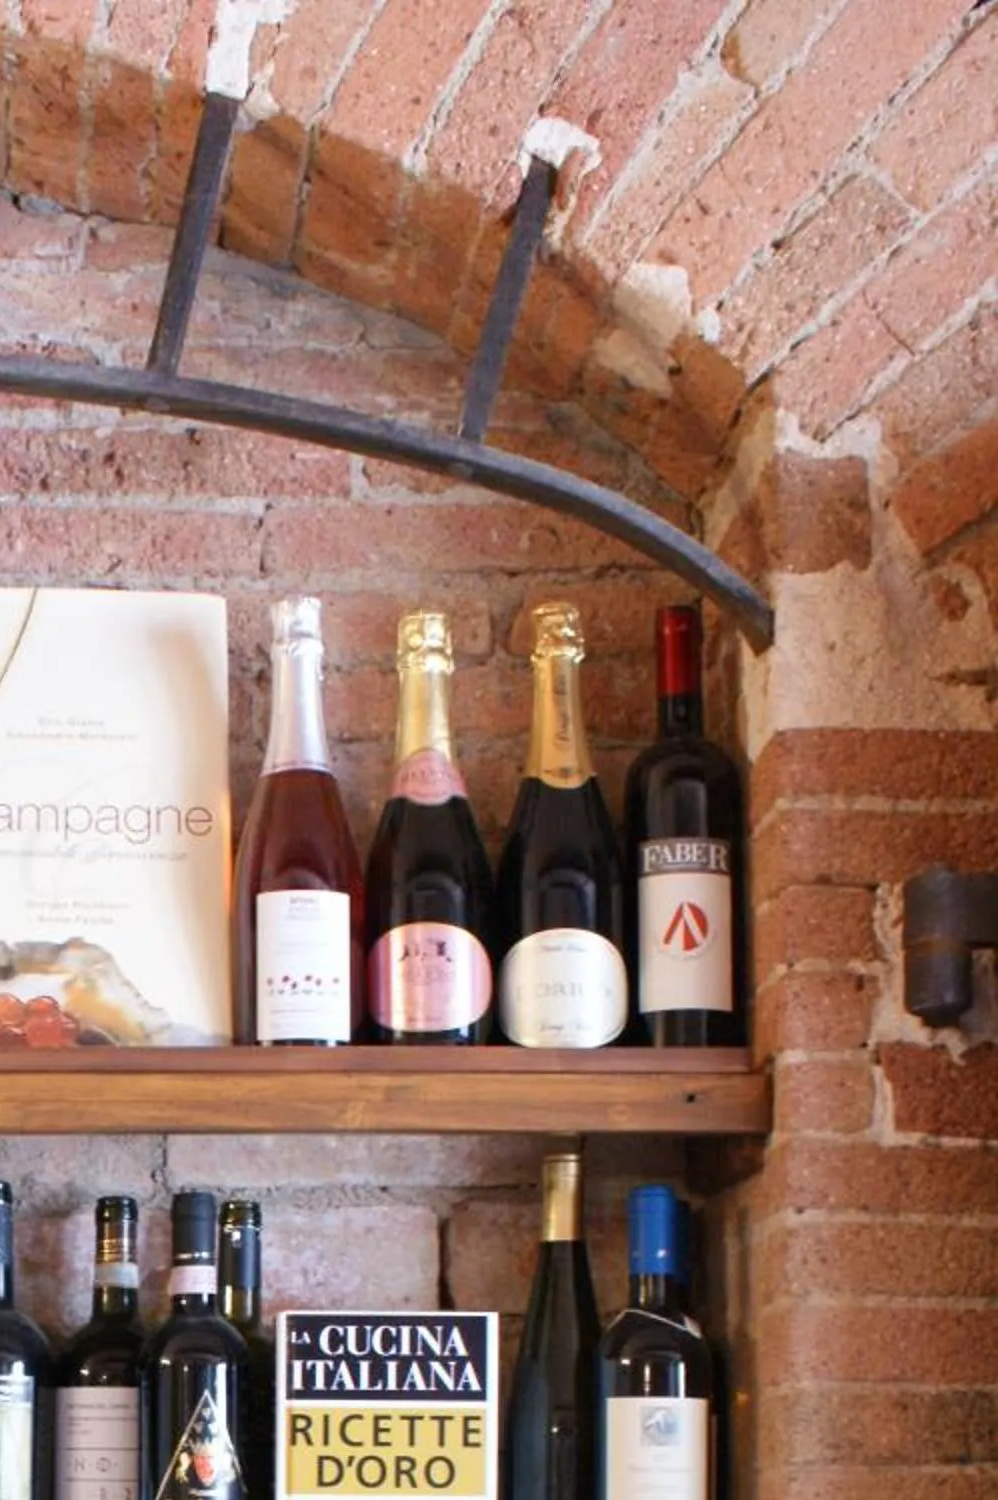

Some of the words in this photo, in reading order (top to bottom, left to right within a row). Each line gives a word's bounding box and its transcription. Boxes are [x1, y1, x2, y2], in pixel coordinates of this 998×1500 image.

[641, 842, 729, 872] FABER
[290, 1330, 311, 1344] LA
[318, 1324, 469, 1358] CUCINA
[291, 1359, 482, 1391] ITALIANA
[290, 1413, 482, 1448] RICETTE
[316, 1455, 456, 1489] D'ORO
